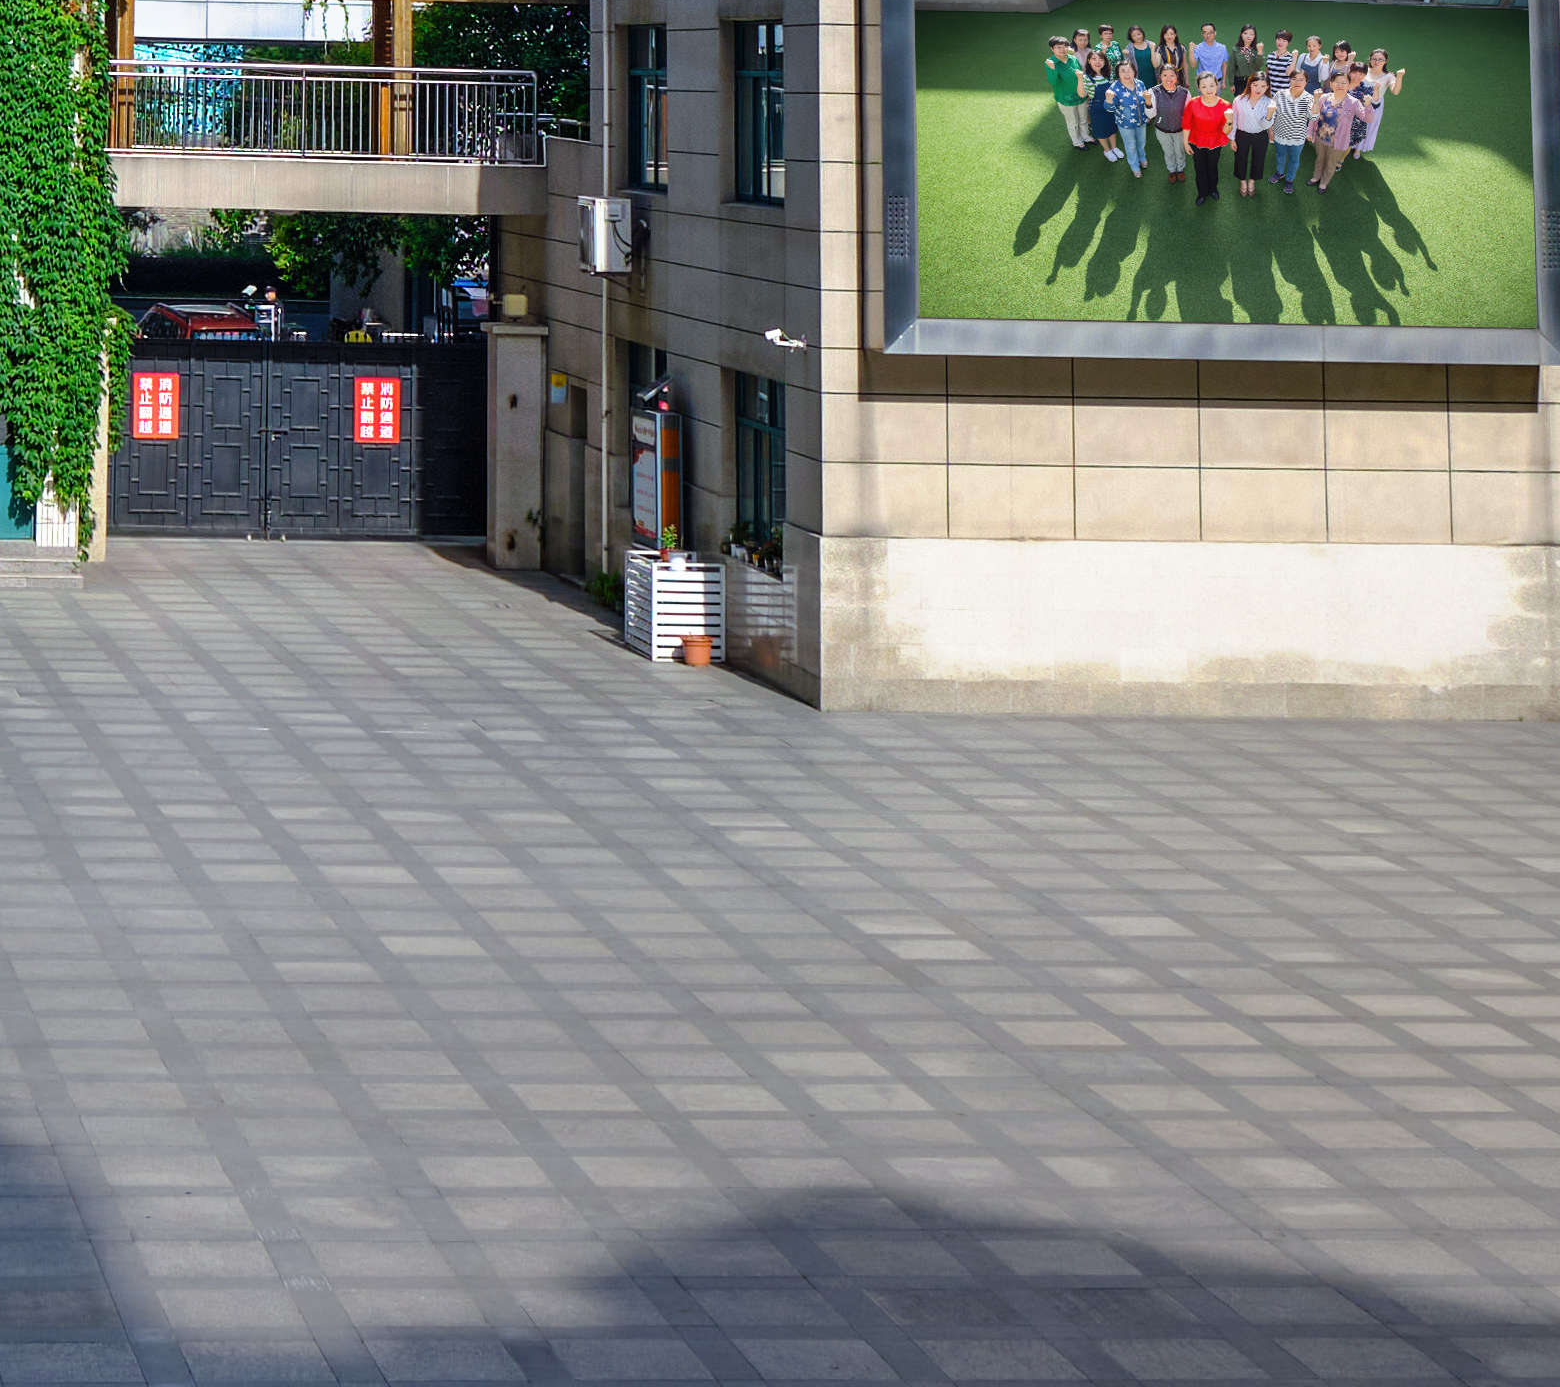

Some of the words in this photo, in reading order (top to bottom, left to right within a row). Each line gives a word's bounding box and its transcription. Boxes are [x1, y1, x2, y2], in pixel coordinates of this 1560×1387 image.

[138, 377, 153, 434] 禁止翻越
[158, 377, 173, 435] 消防通道
[360, 382, 375, 439] 禁止翻越
[379, 382, 394, 439] 消防通道
